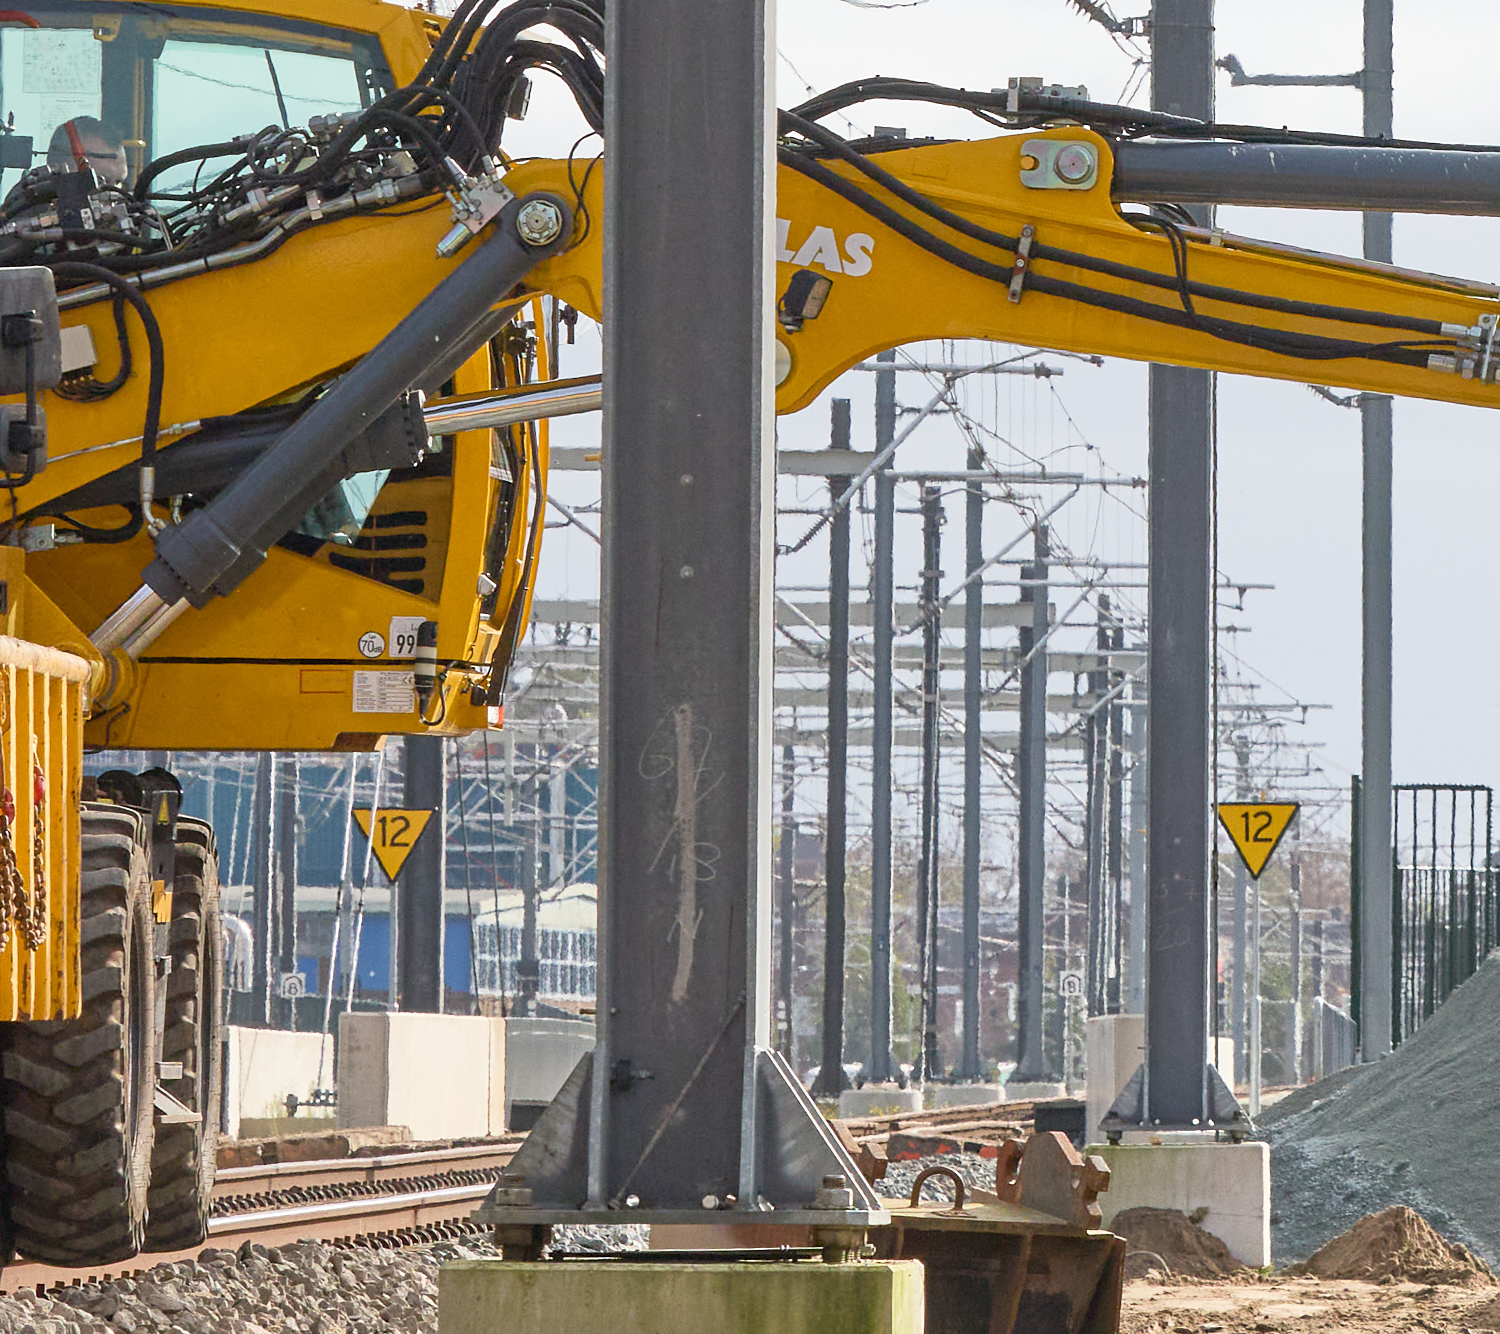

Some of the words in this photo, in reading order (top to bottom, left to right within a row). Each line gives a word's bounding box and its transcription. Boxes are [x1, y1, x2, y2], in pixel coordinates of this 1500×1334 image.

[776, 217, 875, 277] LAS
[397, 634, 415, 654] 99
[378, 815, 411, 848] 12
[1241, 811, 1273, 843] 12
[288, 982, 298, 996] 8
